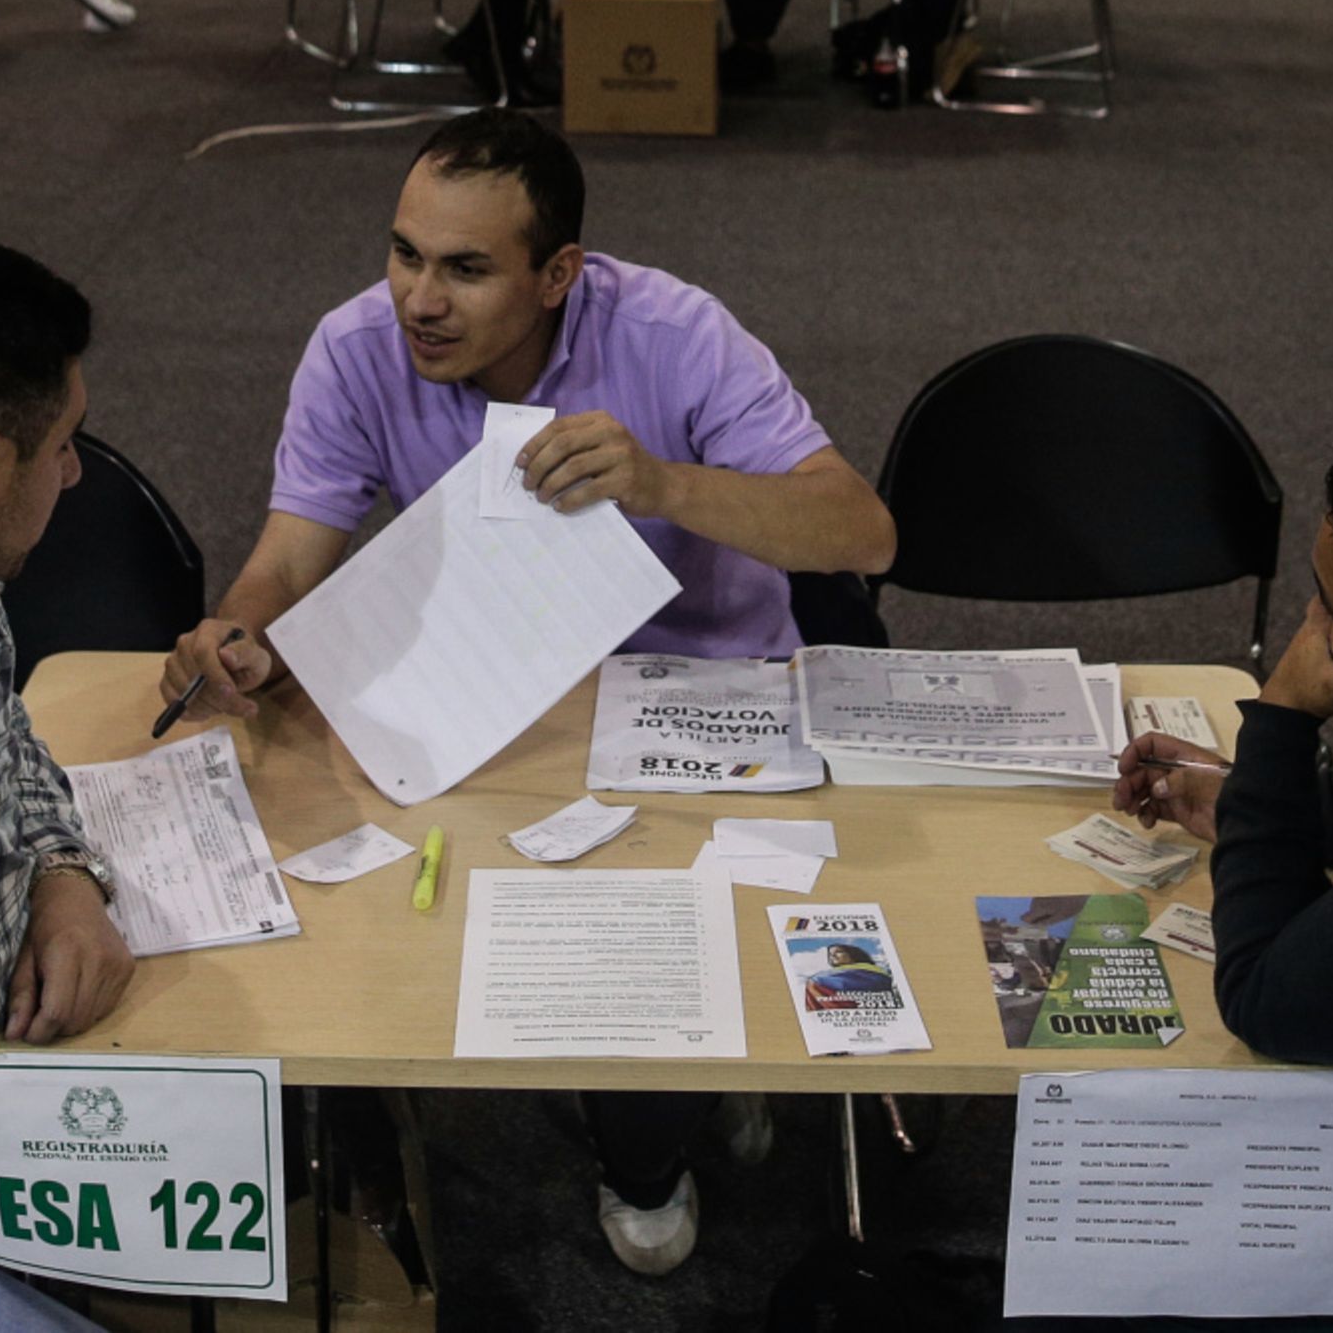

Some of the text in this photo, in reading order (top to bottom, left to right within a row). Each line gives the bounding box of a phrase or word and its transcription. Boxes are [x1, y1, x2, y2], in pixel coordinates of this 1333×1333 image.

[641, 706, 775, 721] VOTACIÓN
[632, 718, 792, 735] JURADOS DE
[659, 731, 758, 744] CARTILLA
[641, 757, 723, 773] 2018
[639, 770, 723, 780] ELECCIONES
[817, 920, 879, 932] 2018
[22, 1140, 169, 1155] REGISTRADURÍA
[22, 1151, 72, 1160] NACIONAL
[150, 1179, 267, 1253] 122
